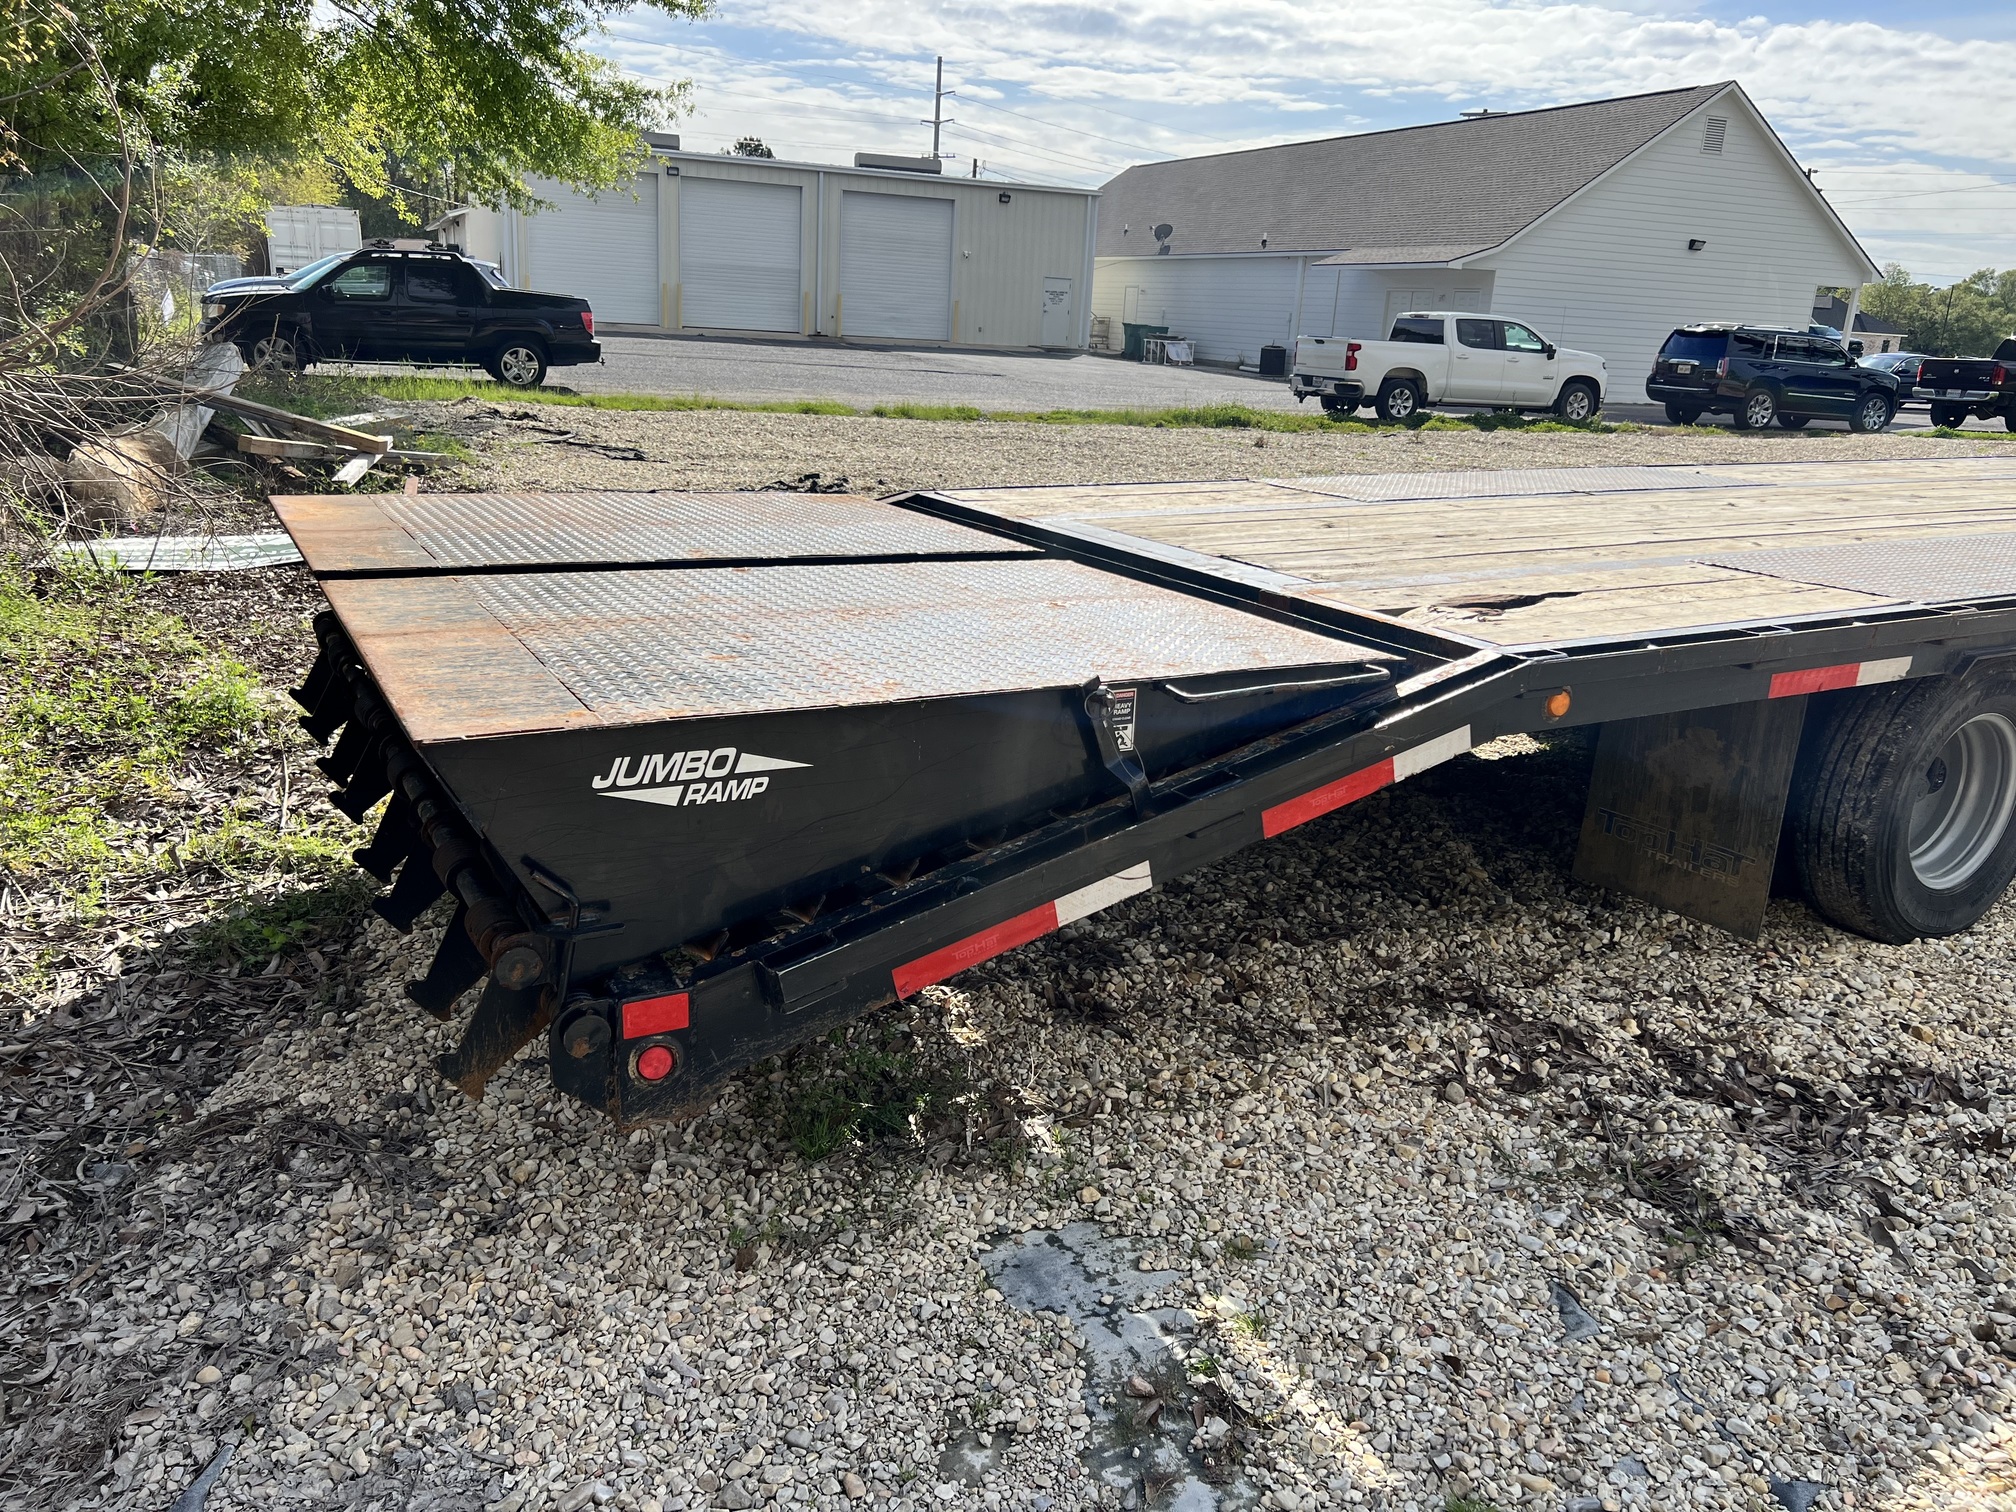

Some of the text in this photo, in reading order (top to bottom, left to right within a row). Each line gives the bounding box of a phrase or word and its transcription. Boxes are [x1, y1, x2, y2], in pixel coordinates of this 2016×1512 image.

[592, 747, 737, 789] JUMBO
[683, 777, 769, 806] RAMP
[1646, 849, 1740, 888] TRAILERS
